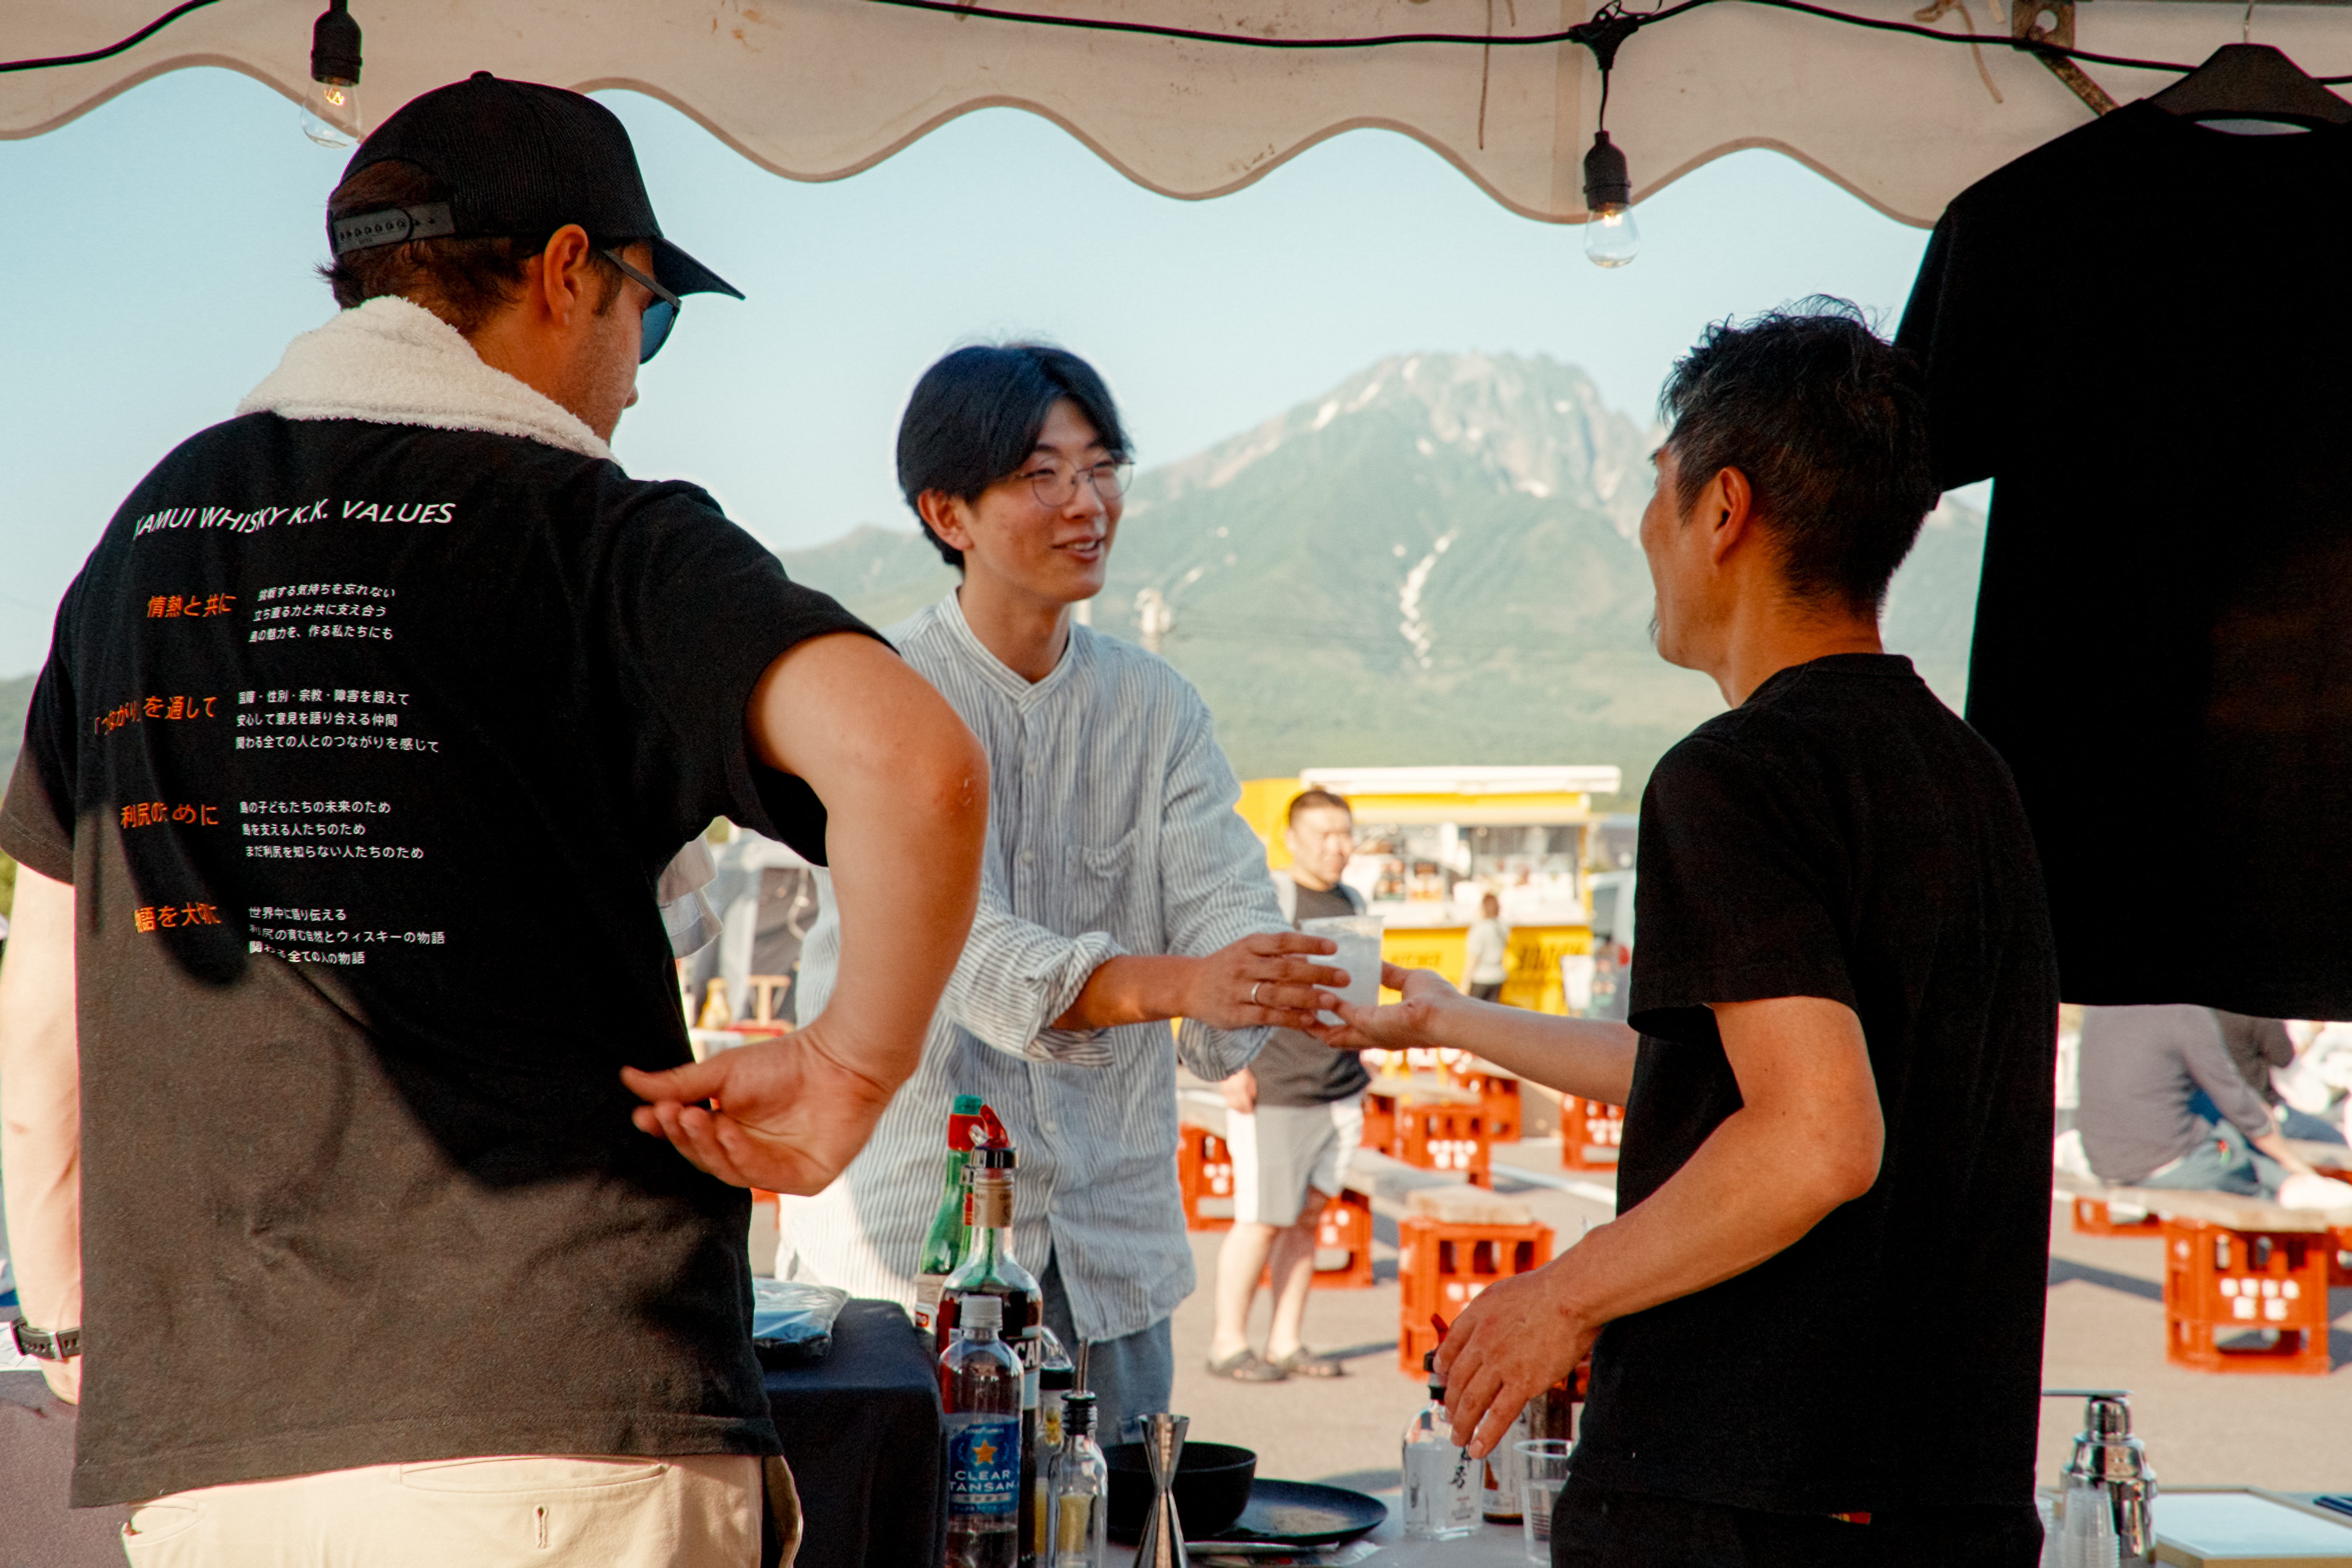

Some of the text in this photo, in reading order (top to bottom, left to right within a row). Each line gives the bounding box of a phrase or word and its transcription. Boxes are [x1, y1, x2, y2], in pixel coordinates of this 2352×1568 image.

[199, 507, 290, 533] WHISKY
[287, 498, 329, 525] K.K.
[342, 501, 456, 523] VALUES
[257, 583, 395, 601] する気持ちを忘れない
[147, 593, 237, 618] 情熱と共に
[253, 604, 387, 622] 立ち直る力と共に支え合う
[236, 711, 398, 727] 安心して意見を語り合える仲間
[236, 734, 439, 753] 関わる全ての人とのつながりを感じて
[240, 800, 391, 813] 島の子どもたちの未来のため
[242, 823, 366, 836] 島を支える人たちのため
[245, 845, 424, 859] まだ利尻を知らない人たちのため
[954, 1470, 1010, 1481] CLEAR
[950, 1481, 1015, 1493] TANSAN
